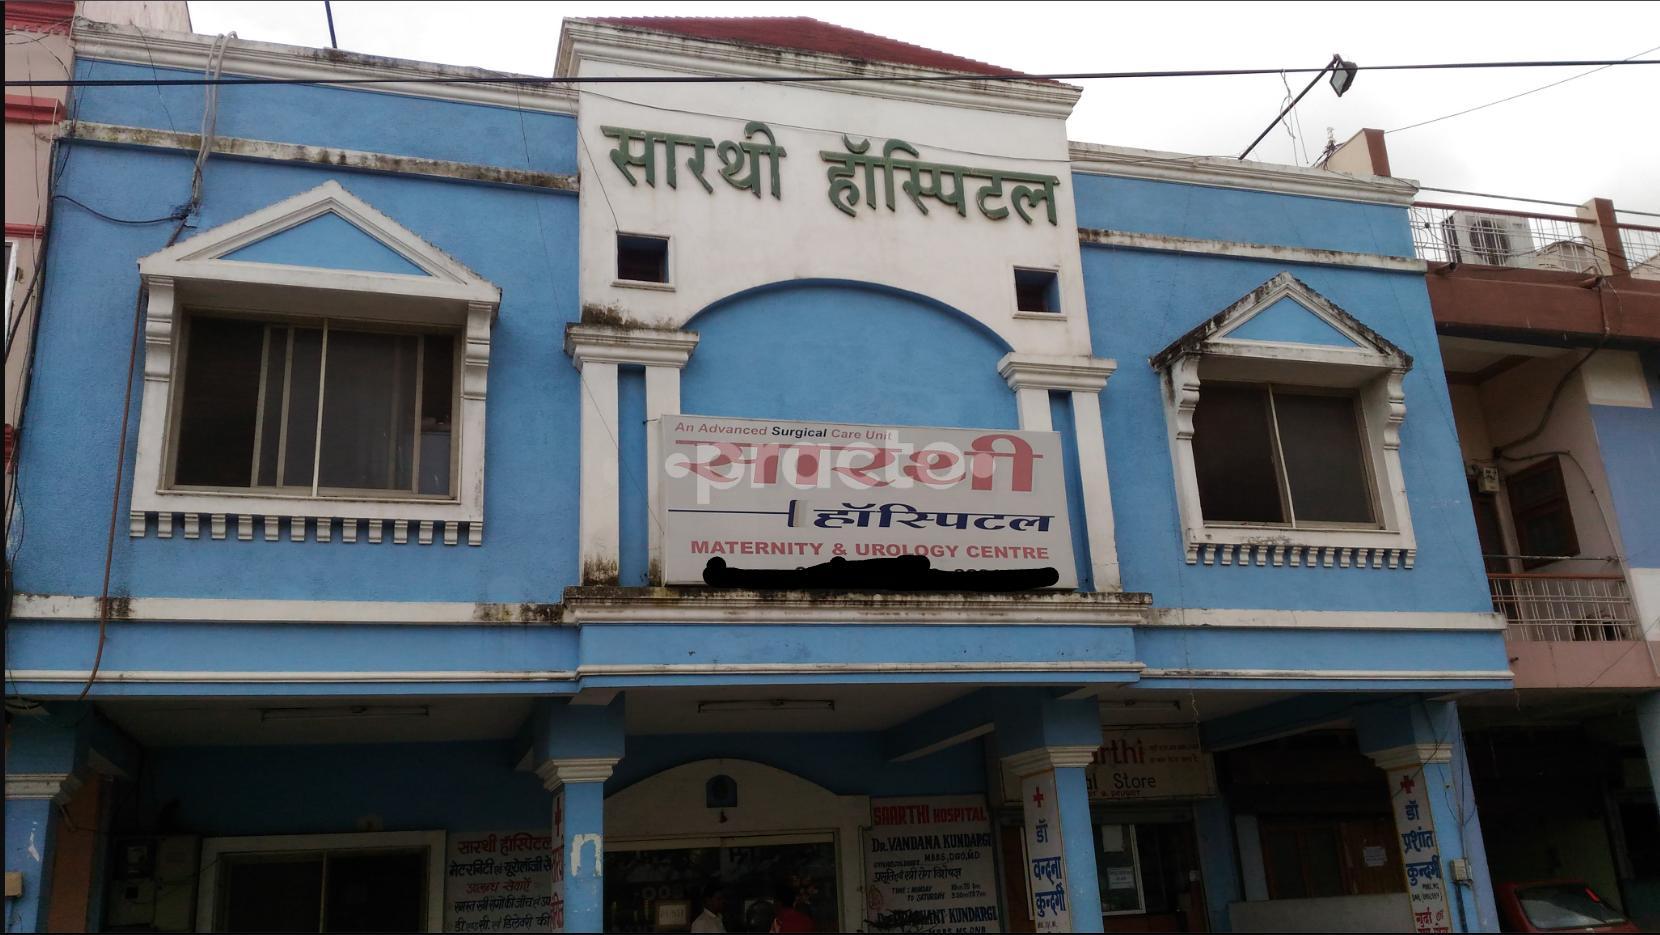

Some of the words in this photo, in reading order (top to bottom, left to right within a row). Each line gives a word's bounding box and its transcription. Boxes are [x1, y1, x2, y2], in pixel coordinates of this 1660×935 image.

[600, 120, 787, 201] सारथी
[819, 132, 1061, 227] हॉस्पिटल
[675, 421, 694, 433] An
[698, 423, 768, 436] Advanced
[771, 426, 828, 440] Surgical
[831, 429, 863, 440] Care
[865, 430, 893, 440] Unit
[813, 503, 1056, 533] हॉस्पिटल
[691, 540, 824, 556] MATERNITY
[832, 543, 848, 556] &
[855, 543, 959, 558] UROLOGY
[966, 545, 1050, 560] CENTRE
[1113, 771, 1157, 790] Store
[933, 806, 987, 823] HOSPITAL
[457, 833, 497, 855] सारथी
[948, 906, 998, 923] KUNDARGI
